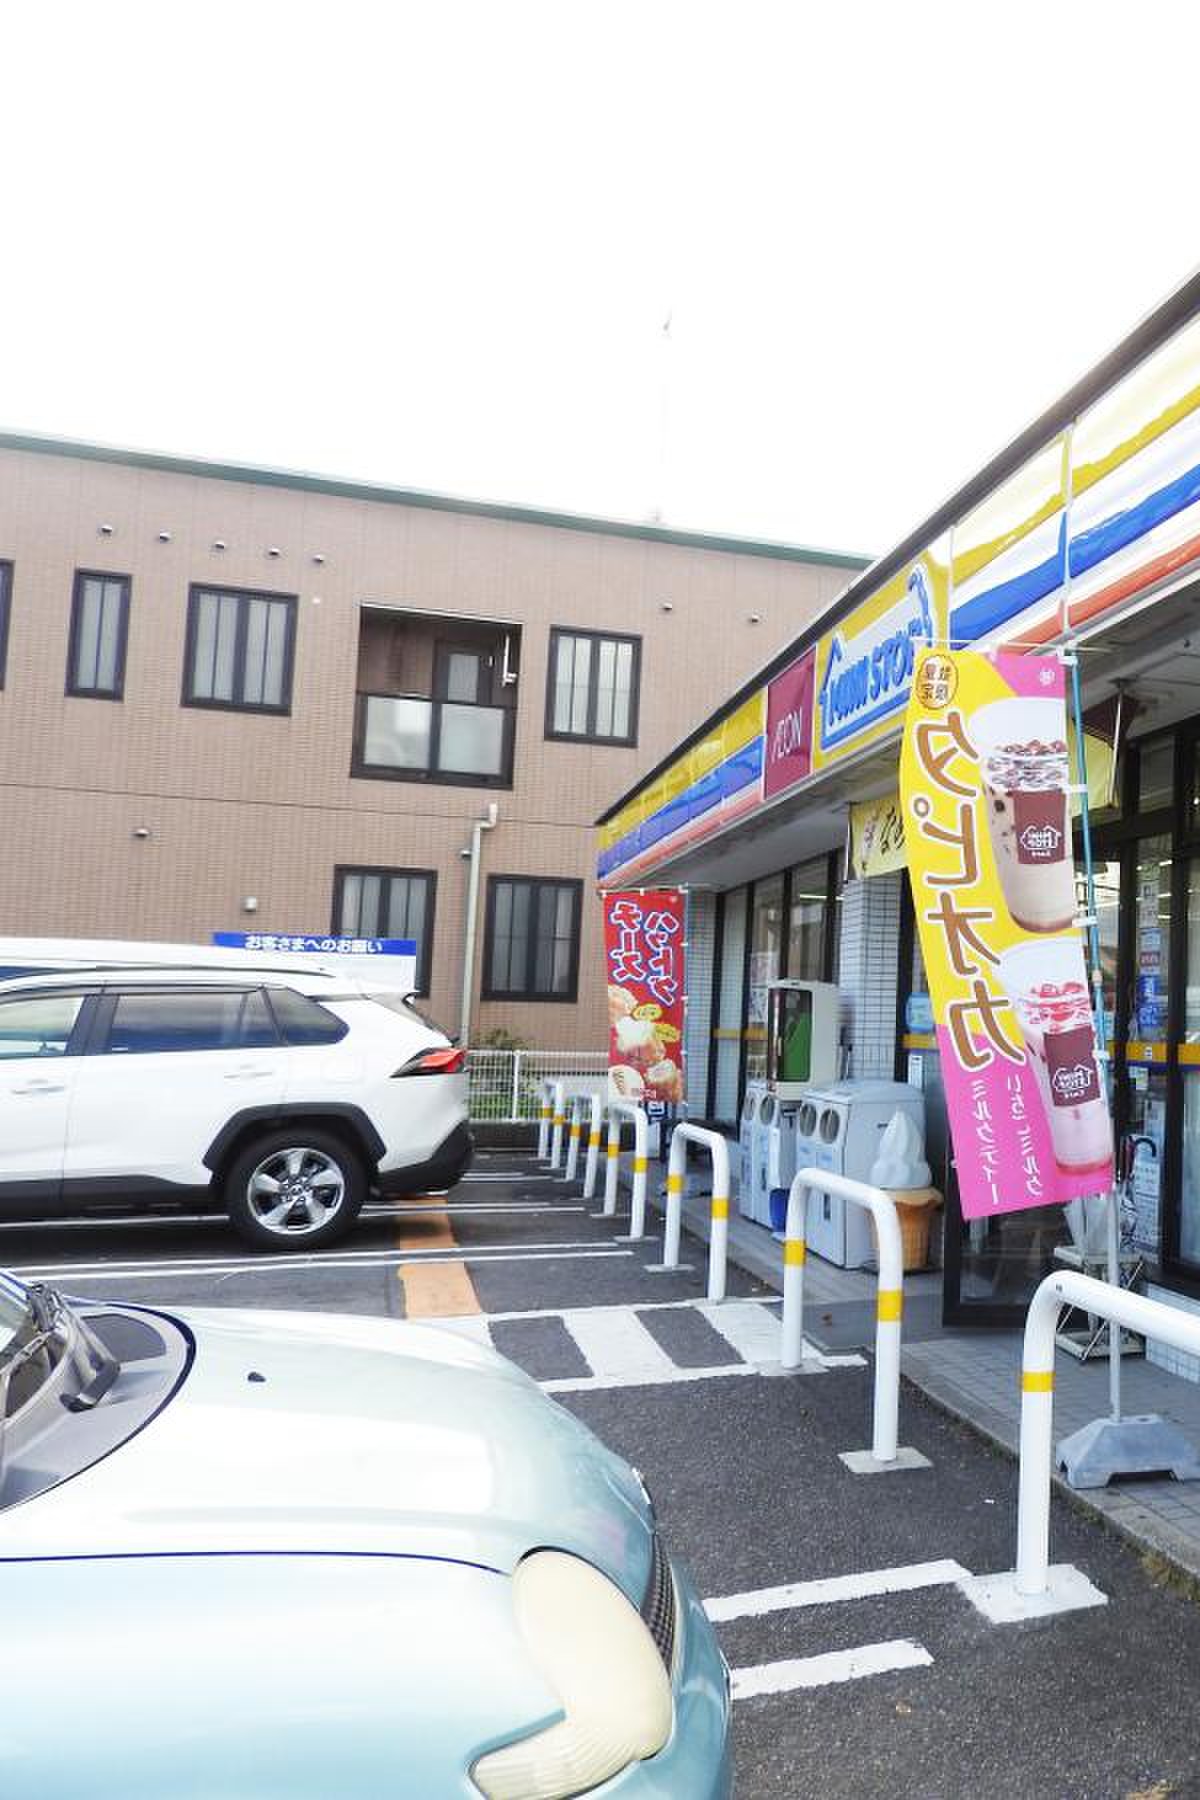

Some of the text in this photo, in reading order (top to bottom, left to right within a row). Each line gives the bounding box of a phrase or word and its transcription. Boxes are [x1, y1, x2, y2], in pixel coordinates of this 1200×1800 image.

[245, 935, 382, 954] お客さまへのお願い
